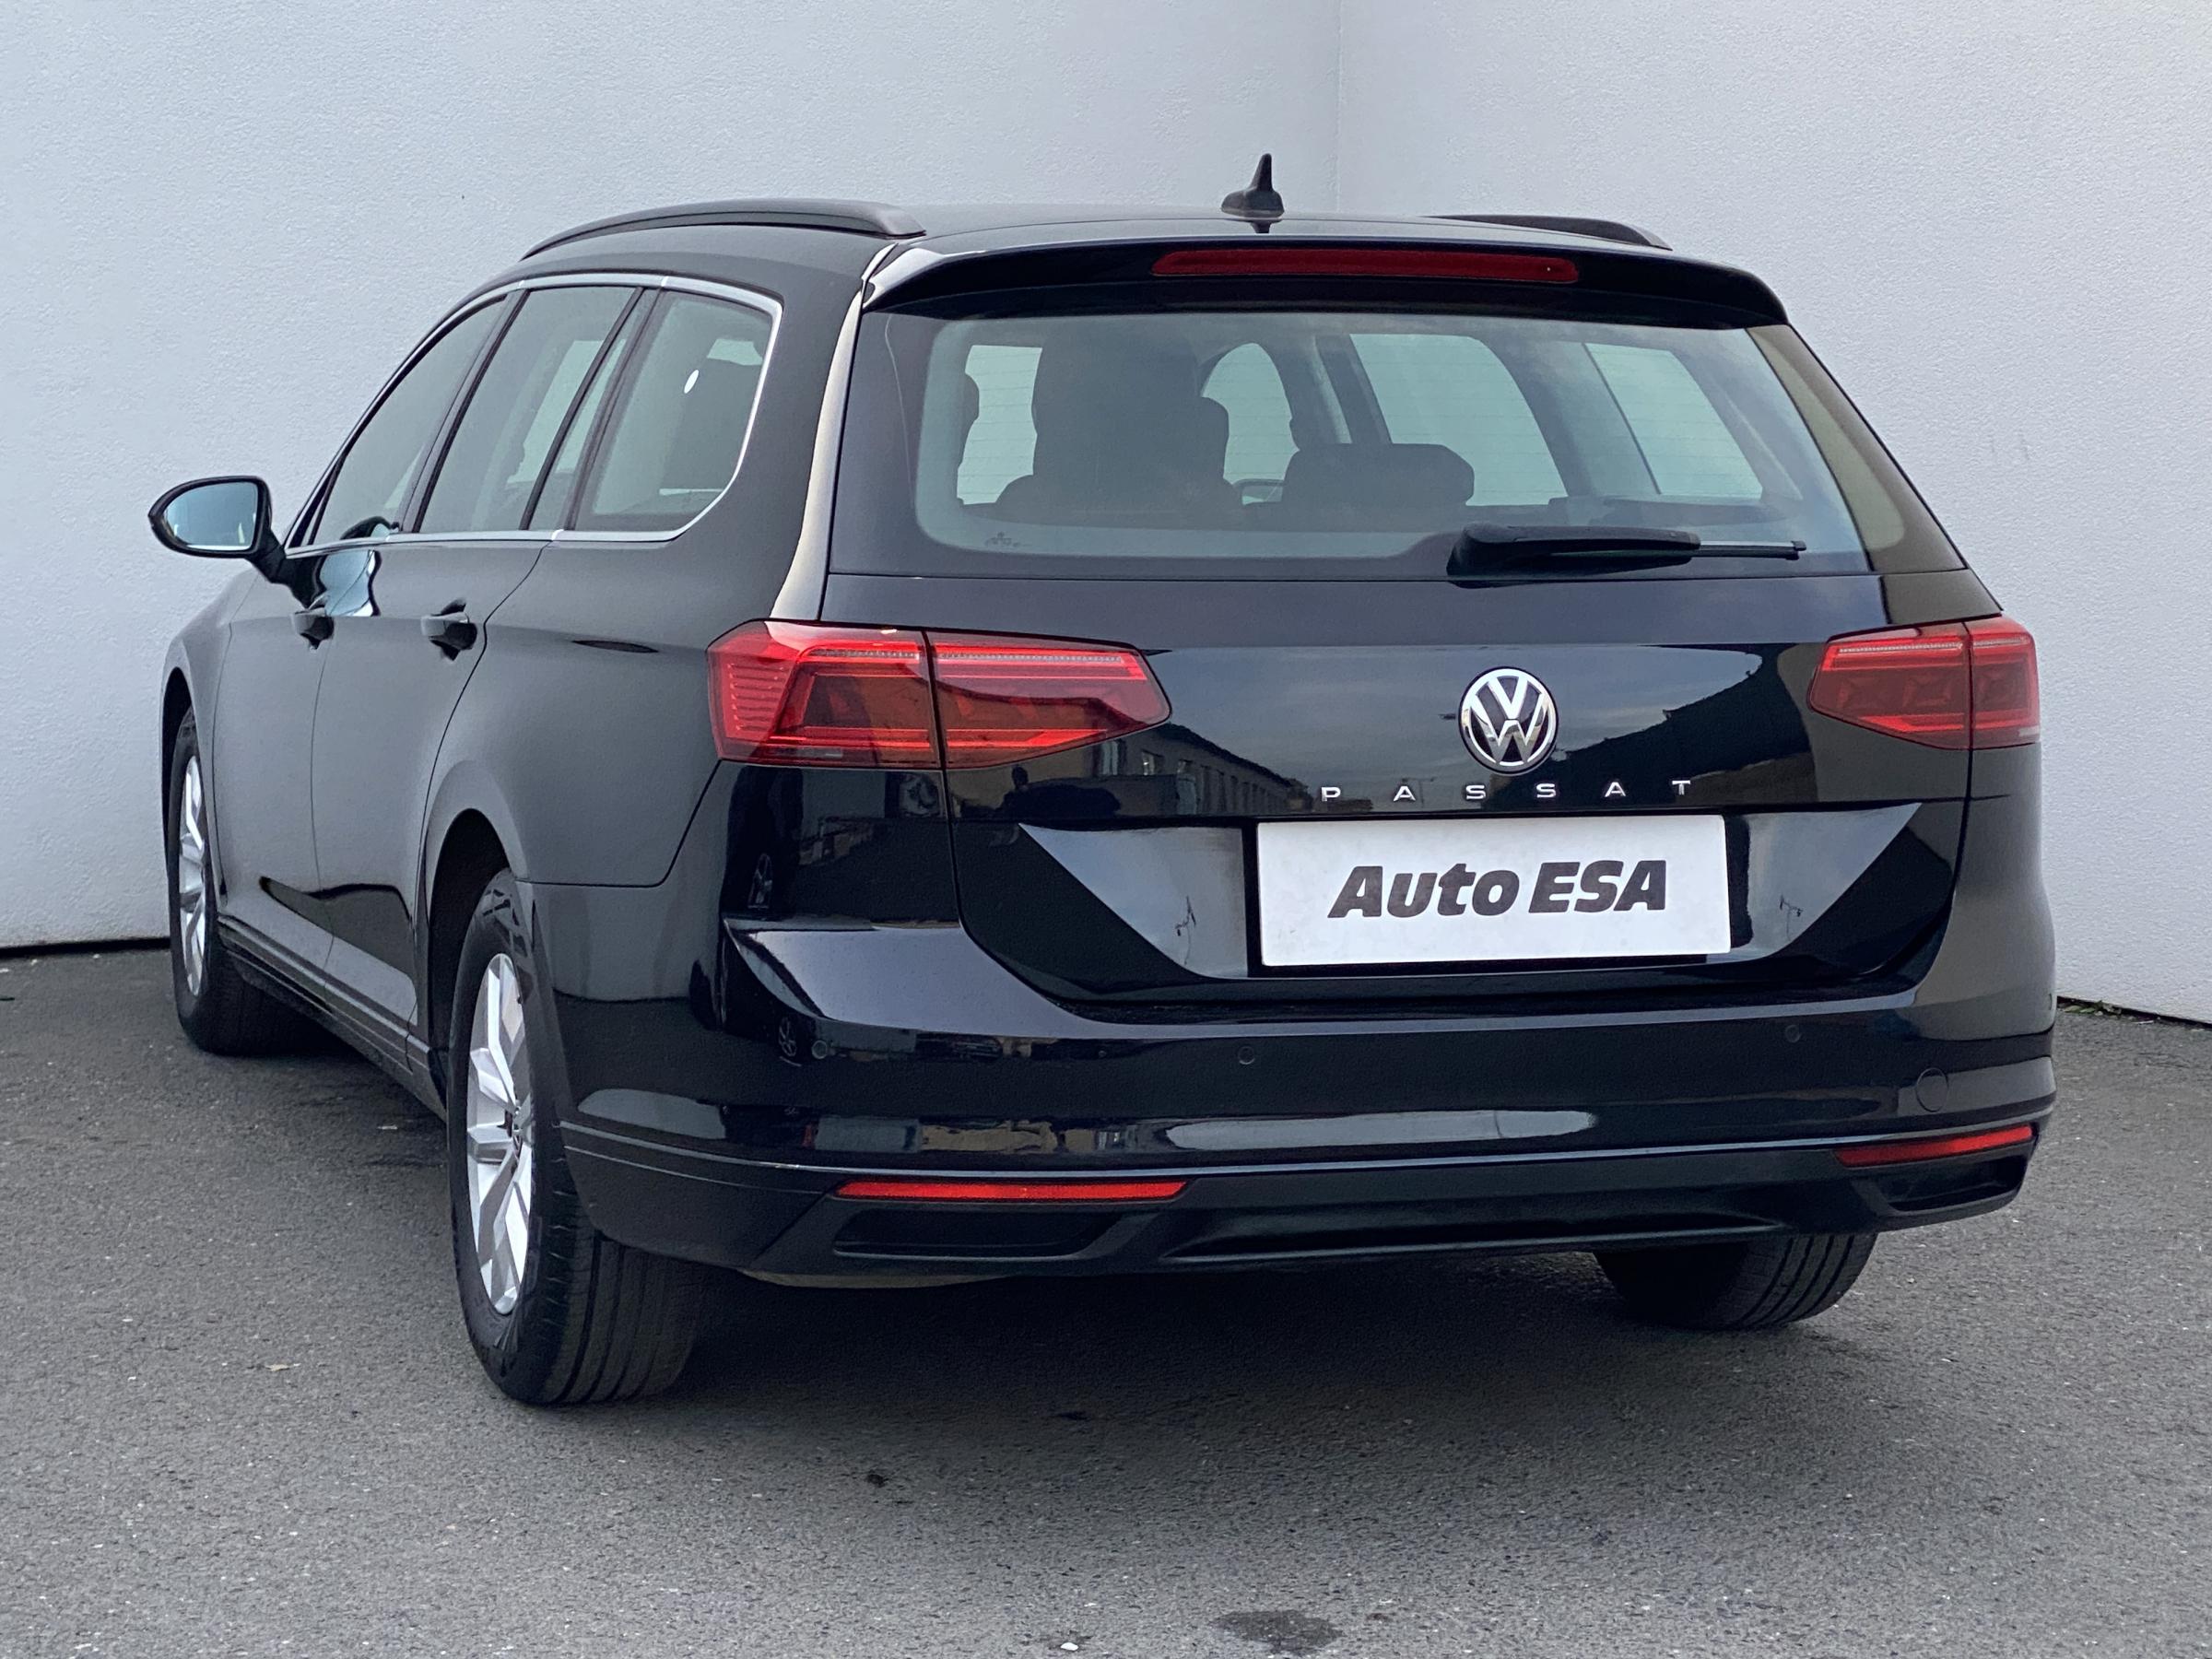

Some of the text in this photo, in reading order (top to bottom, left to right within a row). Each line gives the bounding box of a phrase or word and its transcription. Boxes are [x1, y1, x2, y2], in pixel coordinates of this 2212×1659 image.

[1463, 670, 1557, 770] VW
[1320, 780, 1692, 803] PASSAT
[1327, 859, 1666, 919] Auto ESA
